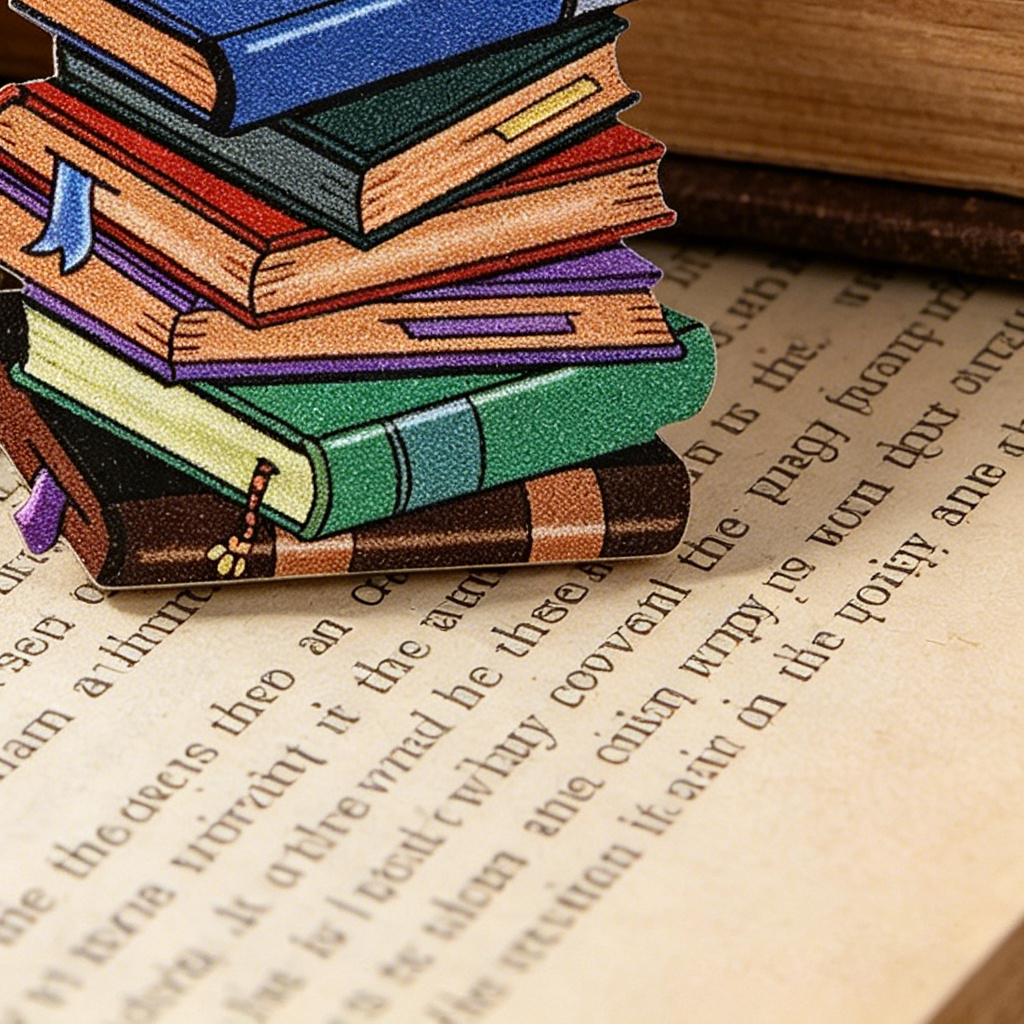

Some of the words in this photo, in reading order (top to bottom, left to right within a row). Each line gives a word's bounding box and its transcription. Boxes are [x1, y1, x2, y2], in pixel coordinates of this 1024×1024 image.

[676, 517, 750, 573] the
[354, 640, 432, 695] the
[774, 631, 845, 682] the
